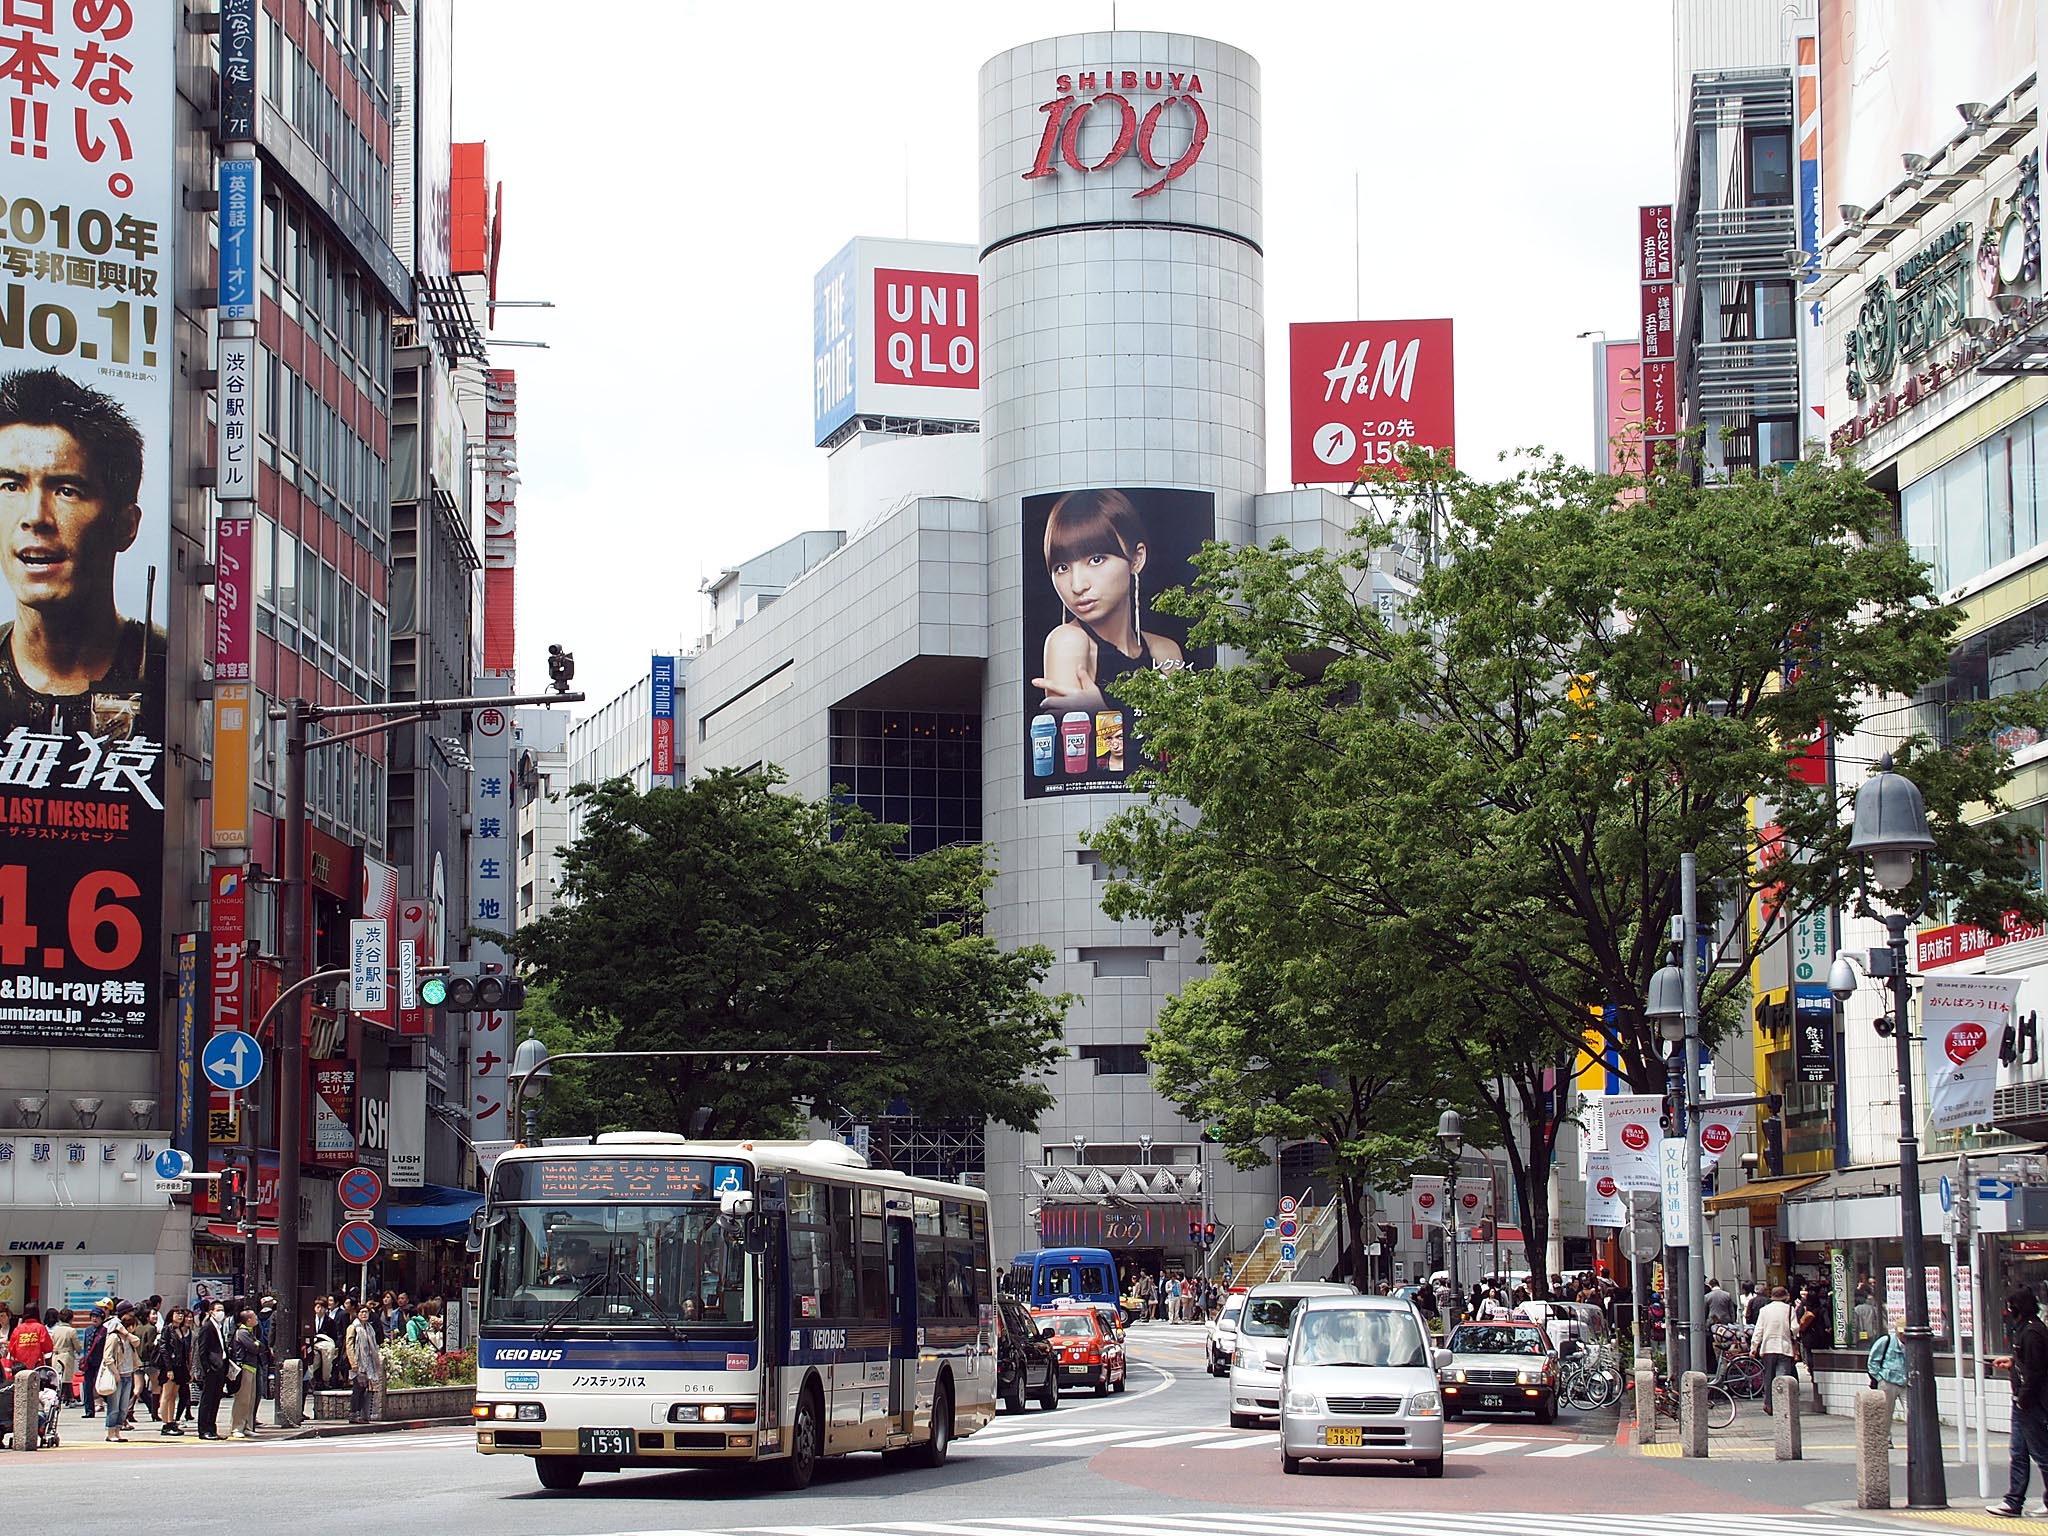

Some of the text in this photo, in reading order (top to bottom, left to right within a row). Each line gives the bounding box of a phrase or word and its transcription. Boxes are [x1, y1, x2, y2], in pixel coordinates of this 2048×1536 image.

[1056, 71, 1202, 94] SHIBUYA
[231, 120, 248, 134] 7F
[1021, 92, 1209, 198] 109
[224, 163, 254, 172] AEON
[1650, 208, 1663, 216] 8F
[0, 195, 159, 261] 010年
[228, 176, 247, 305] 英会話イーオン
[1657, 217, 1670, 273] にんにく屋
[1645, 237, 1657, 279] 五右衛門
[0, 244, 158, 298] 写邦画興収
[1651, 286, 1664, 294] 8F
[228, 305, 245, 319] 6F
[824, 272, 846, 346] THE
[887, 284, 966, 327] UNI
[1646, 313, 1658, 356] 五右衛門
[887, 332, 974, 378] QLO
[1323, 339, 1420, 404] H&M
[1653, 364, 1666, 372] 8F
[816, 332, 852, 421] PRIME
[225, 353, 245, 486] 渋谷駅前ビル
[1362, 419, 1415, 438] この先
[220, 522, 250, 538] 5F
[217, 663, 249, 678] 美容室
[1152, 658, 1194, 672] レクシィ
[222, 688, 244, 698] 4F
[656, 665, 670, 716] THE PRIME
[48, 800, 129, 832] MESSAGE
[216, 831, 244, 842] YOGA
[479, 777, 502, 920] 洋装生地
[212, 897, 244, 905] SUNDRUG
[1920, 936, 1952, 963] 国内旅行
[355, 939, 364, 994] Shibuya Sta.
[366, 926, 382, 1003] 渋谷駅前
[1801, 966, 1811, 977] 1F
[402, 945, 413, 1007] スクランブル式
[1930, 996, 2010, 1013] がんばろう日本
[126, 1010, 146, 1019] DVD
[406, 1014, 419, 1022] 3F
[1951, 1031, 1984, 1040] TEAM
[318, 1071, 355, 1083] 喫茶室
[318, 1112, 333, 1120] 3F
[1608, 1106, 1657, 1118] がんばろう日本
[322, 1132, 344, 1140] BAR
[392, 1155, 421, 1164] LUSH
[1665, 1148, 1680, 1229] 文化村通り
[1283, 1201, 1293, 1210] 30
[1105, 1222, 1142, 1246] 109
[9, 1241, 87, 1251] EKIMAE A
[812, 1329, 846, 1350] KEIO BUS
[495, 1349, 563, 1361] KEIO BUS
[727, 1358, 749, 1366] PASMO
[572, 1375, 646, 1388] ノンステップバス
[685, 1385, 715, 1393] D616
[591, 1436, 630, 1454] 15-91
[1333, 1434, 1360, 1445] 38-17
